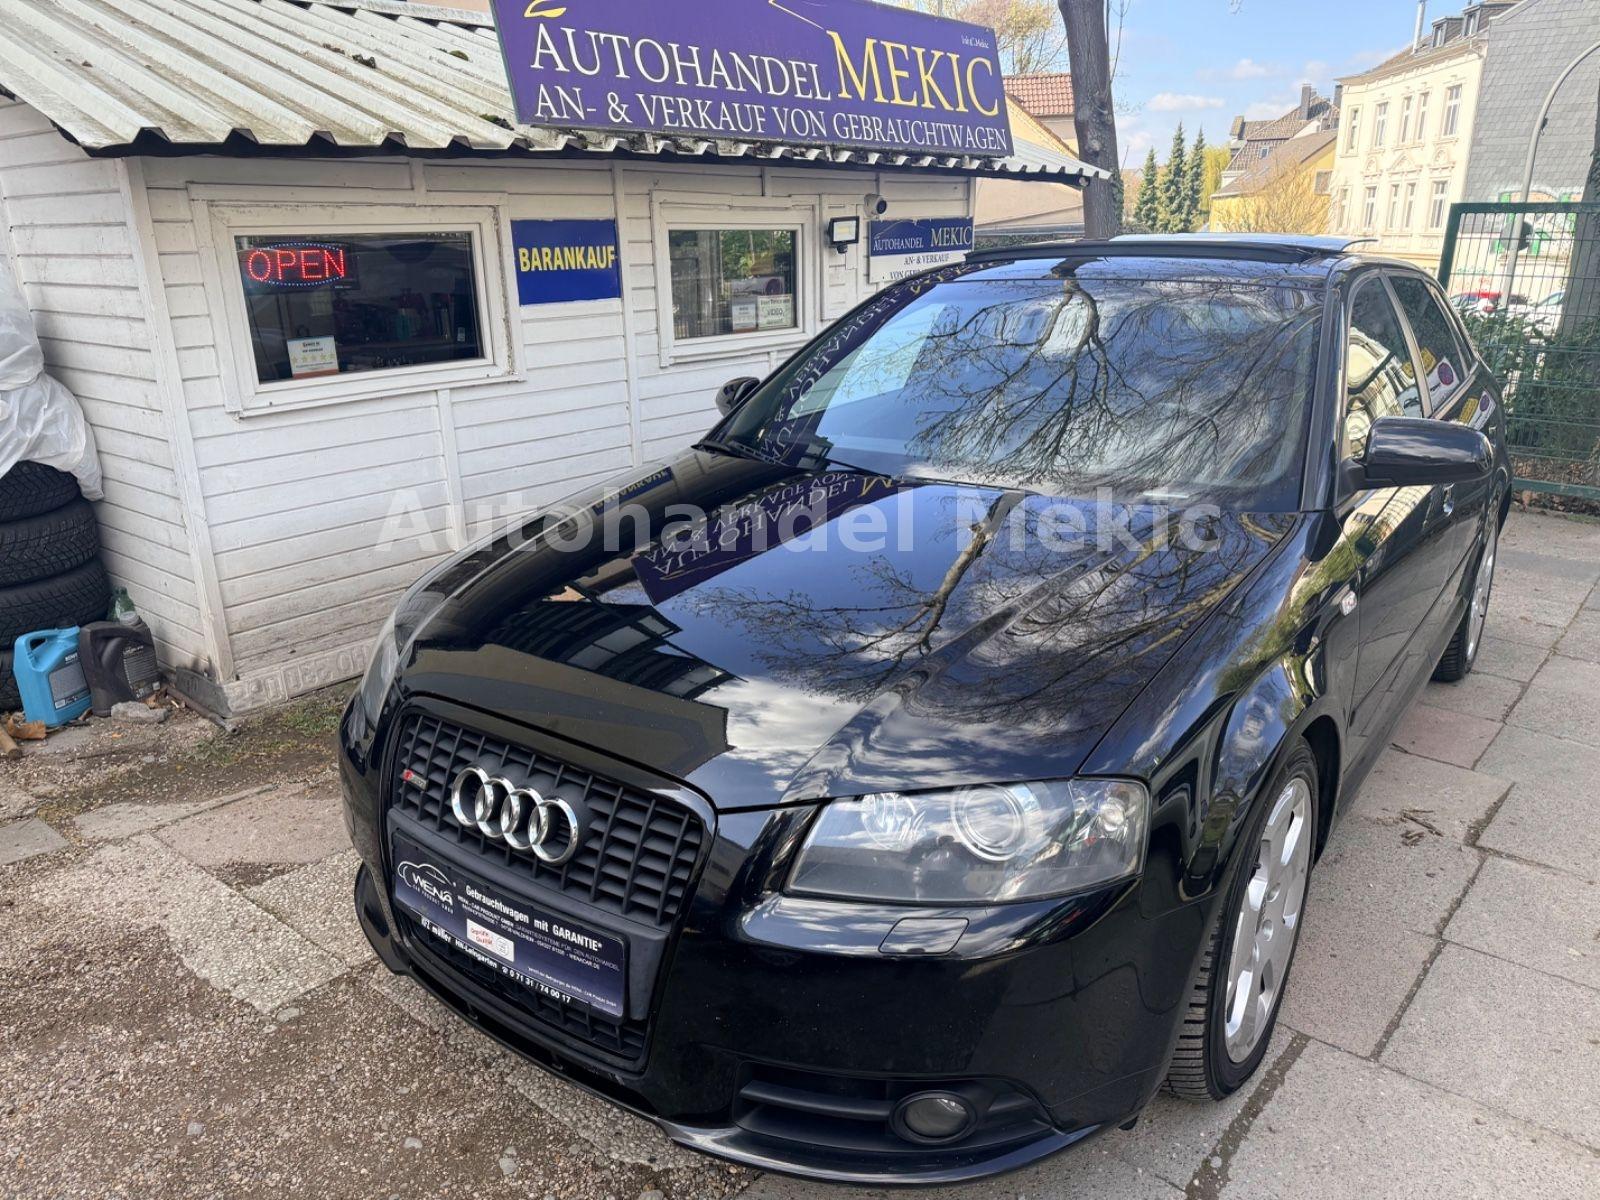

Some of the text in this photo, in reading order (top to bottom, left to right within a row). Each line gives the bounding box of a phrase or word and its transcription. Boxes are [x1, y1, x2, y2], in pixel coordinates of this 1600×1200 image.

[530, 23, 999, 116] AUTOHANDEL MEKIC
[535, 83, 1007, 150] AN- & VERKAUF VON GEBRAUCHTWAGEN
[873, 226, 972, 251] AUTOHANDEL MEKIC
[248, 249, 345, 281] OPEN
[518, 245, 615, 272] BARANKAUF
[921, 253, 949, 264] VERKAUF
[412, 872, 454, 906] WENA
[466, 885, 529, 924] Gebrauchtwagen
[534, 919, 549, 932] mit
[515, 971, 524, 982] 71
[525, 977, 534, 987] 31
[540, 985, 549, 994] 74
[550, 989, 560, 999] 00
[562, 994, 571, 1004] 17
